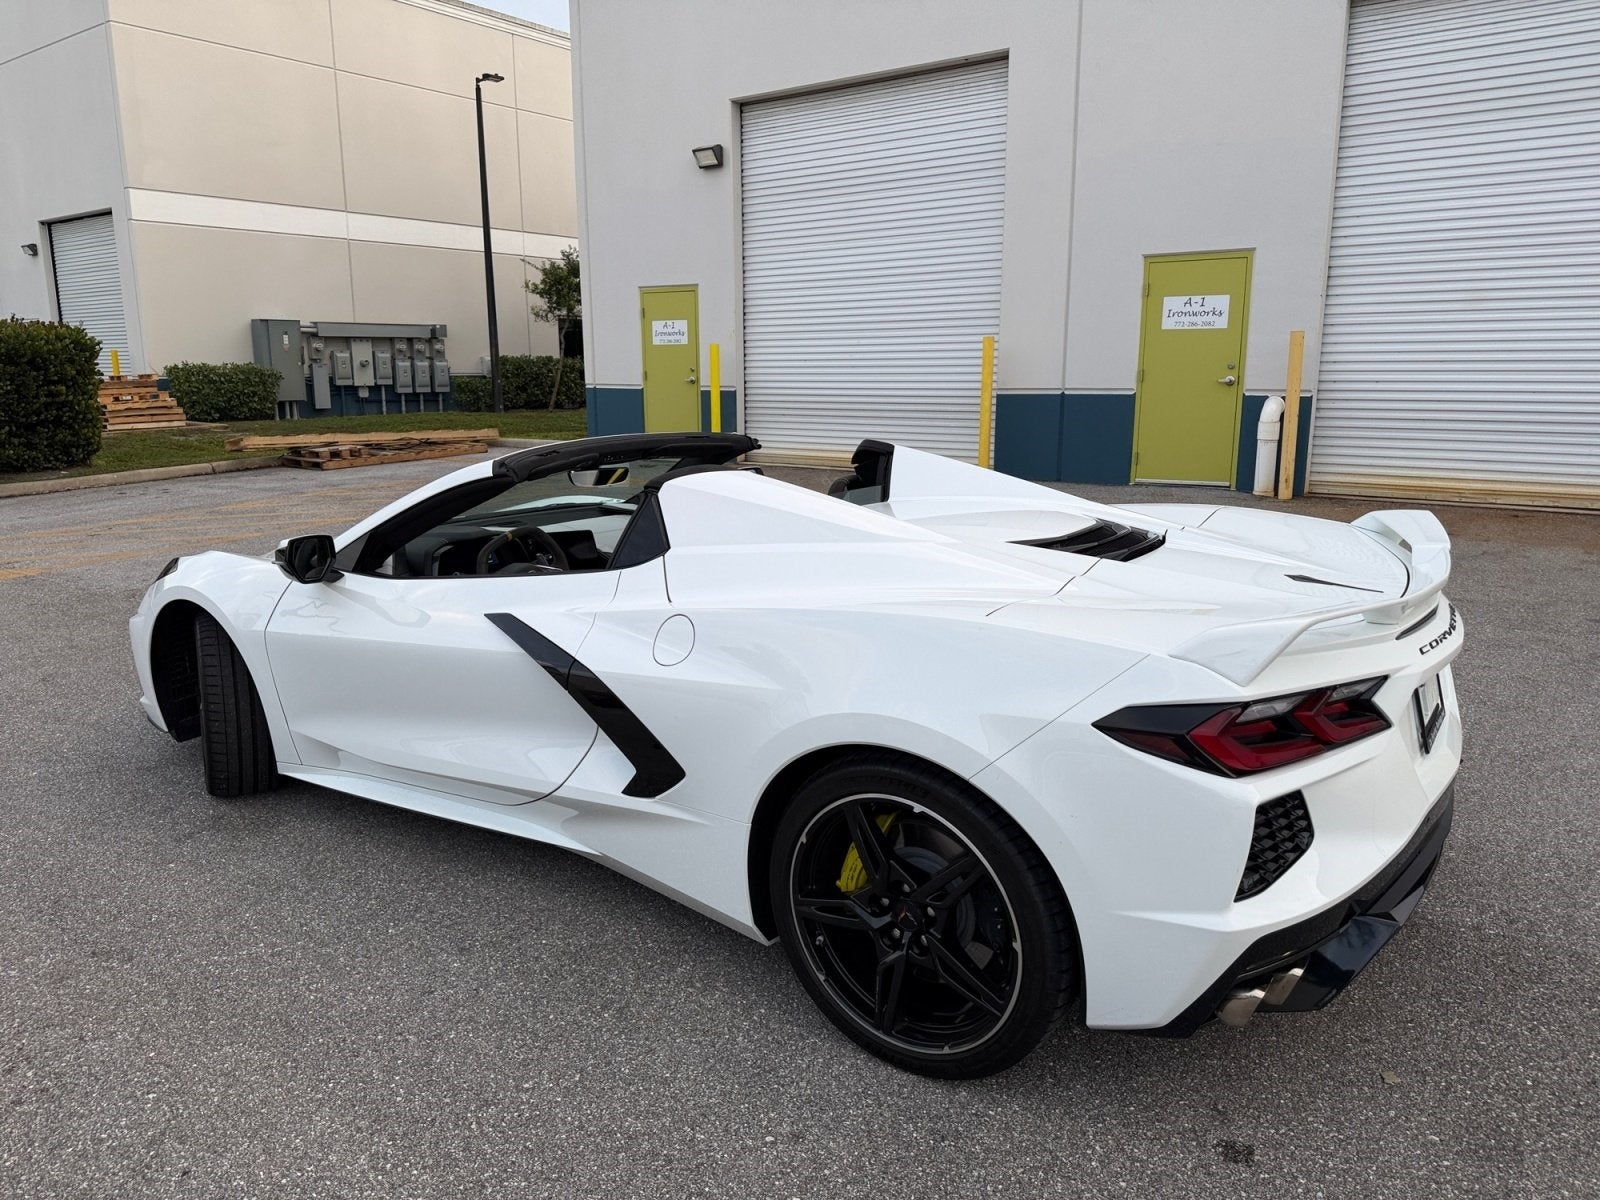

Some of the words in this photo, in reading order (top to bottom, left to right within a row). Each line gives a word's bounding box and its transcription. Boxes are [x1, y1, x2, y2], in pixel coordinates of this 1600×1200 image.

[1183, 296, 1206, 307] A-1
[1167, 306, 1225, 318] Ironworks
[662, 321, 675, 330] A-1
[654, 329, 686, 338] Ironworks
